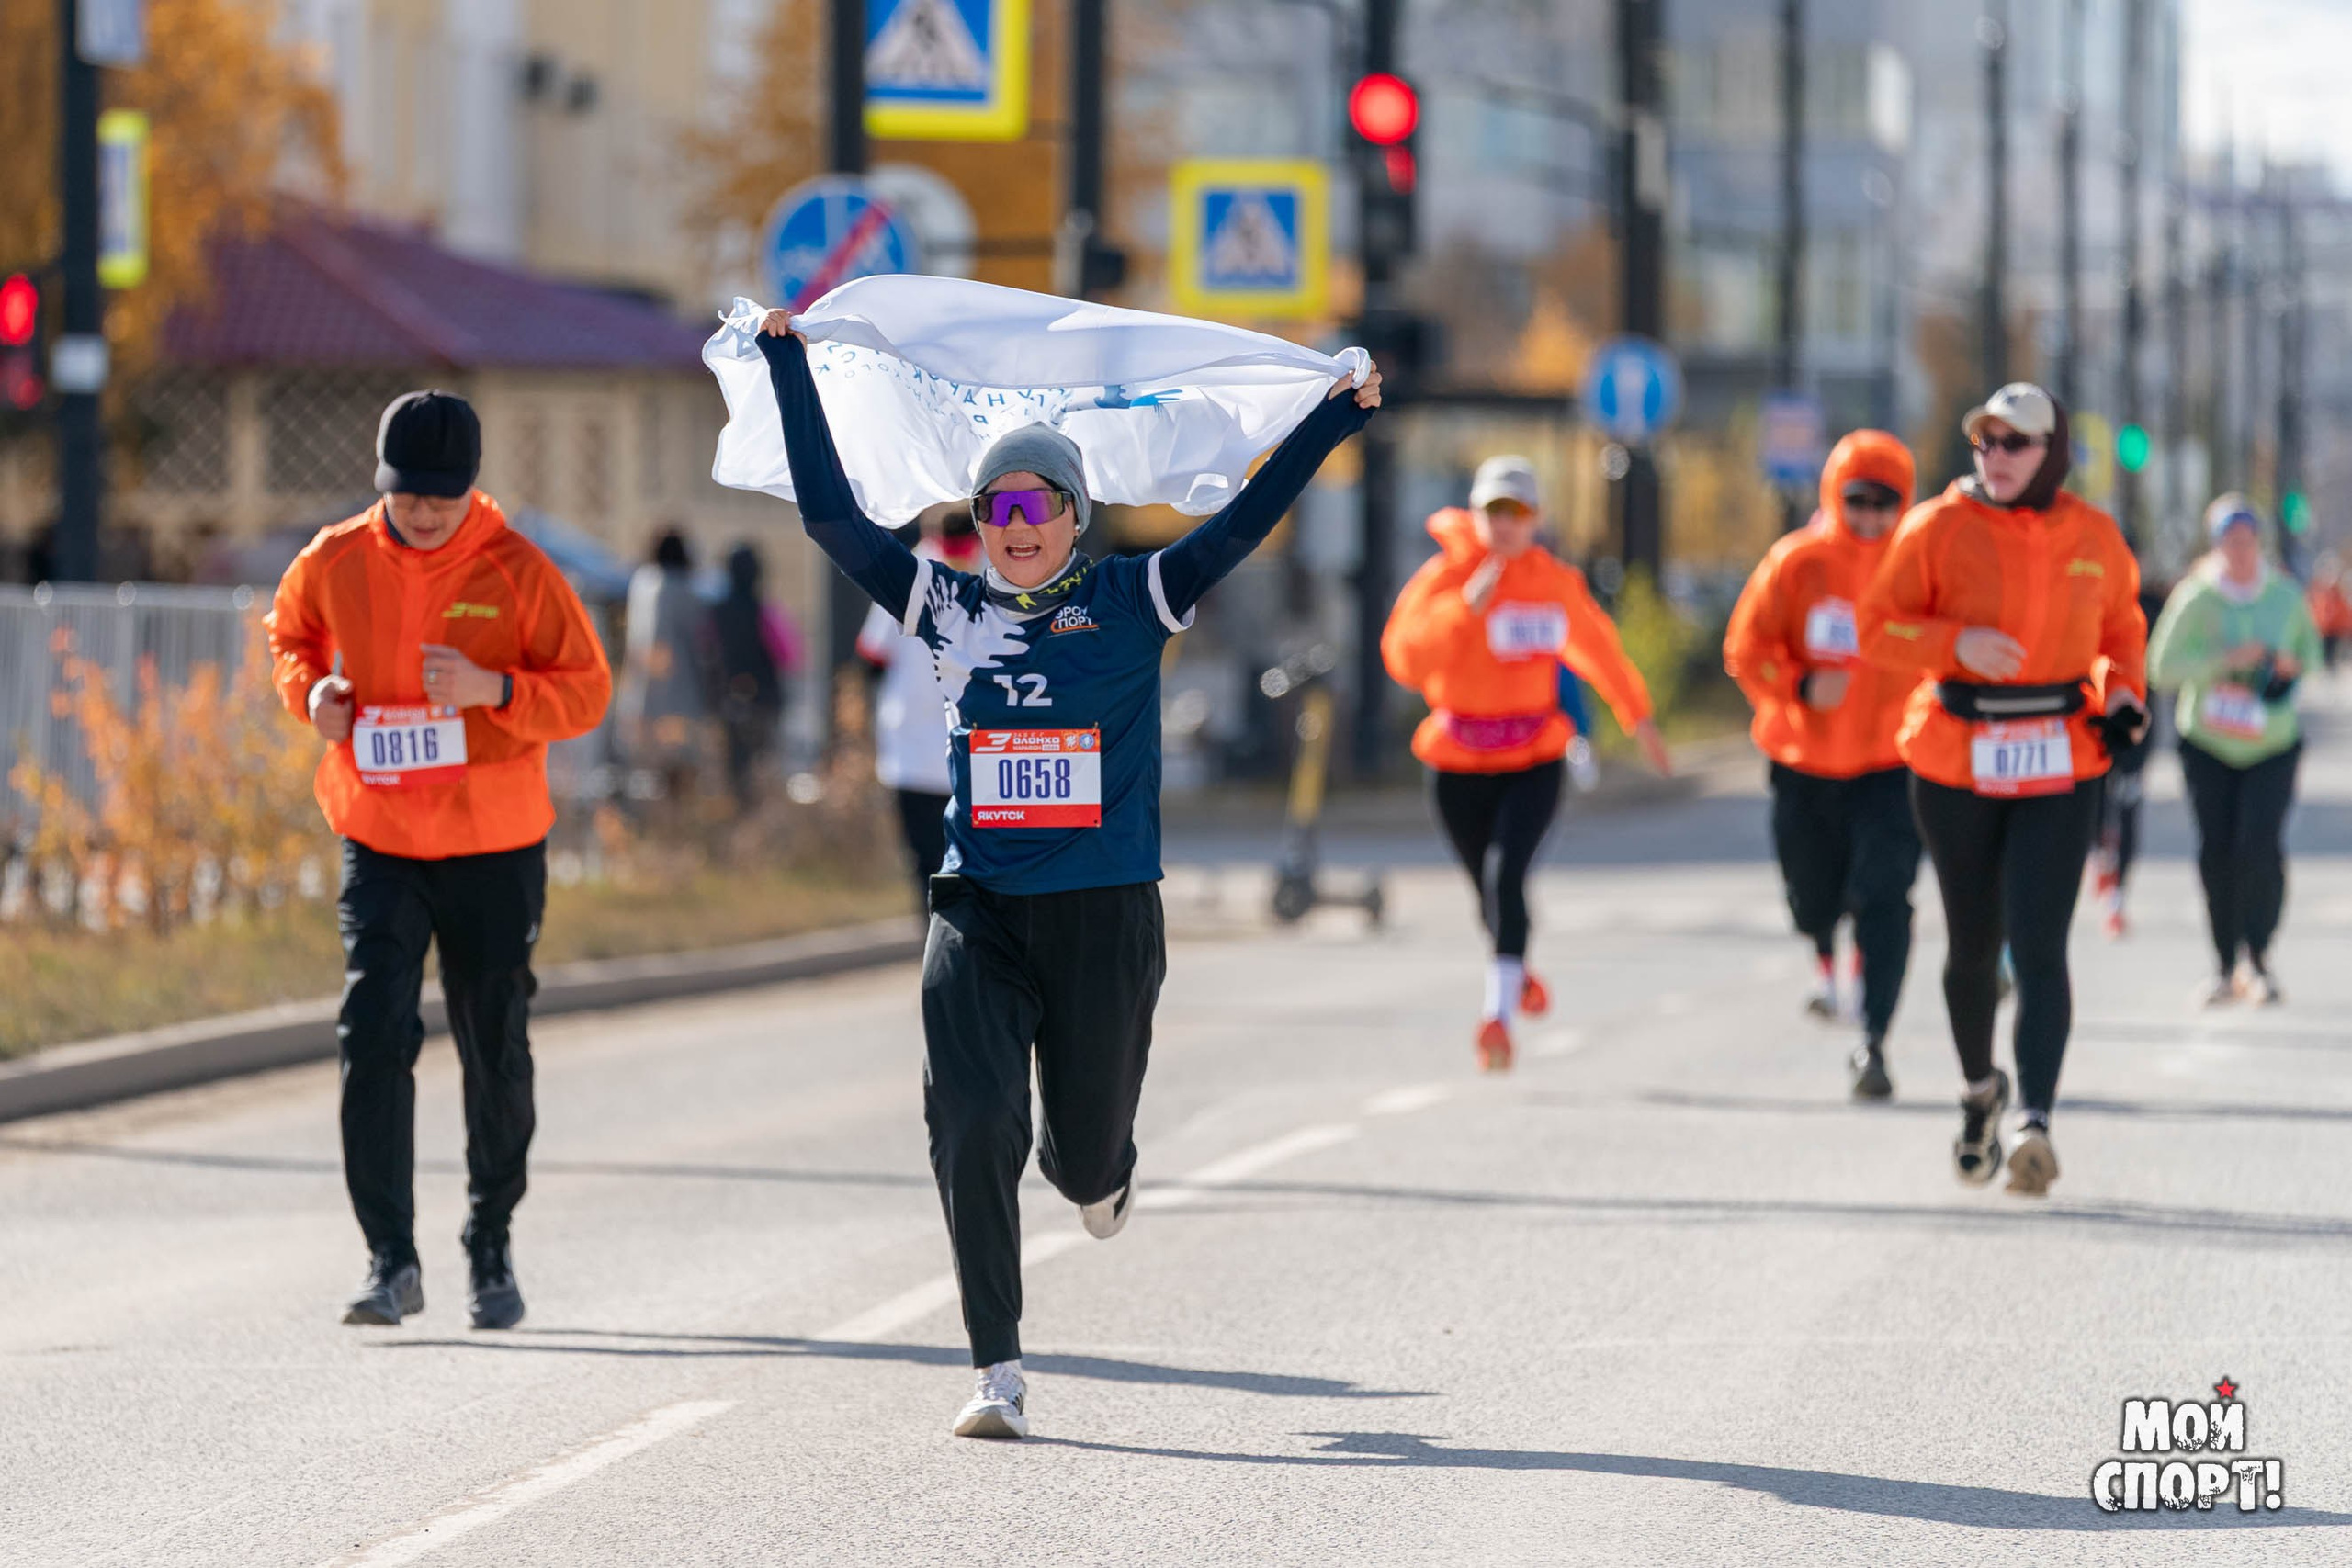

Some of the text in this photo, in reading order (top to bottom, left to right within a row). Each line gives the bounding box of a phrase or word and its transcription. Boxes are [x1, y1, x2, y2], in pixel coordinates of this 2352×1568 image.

[993, 673, 1052, 706] 12
[372, 728, 439, 766] 0816
[1012, 737, 1060, 745] ОЛОНХО
[999, 759, 1070, 799] 0658
[978, 811, 1025, 820] ЯКУТСК
